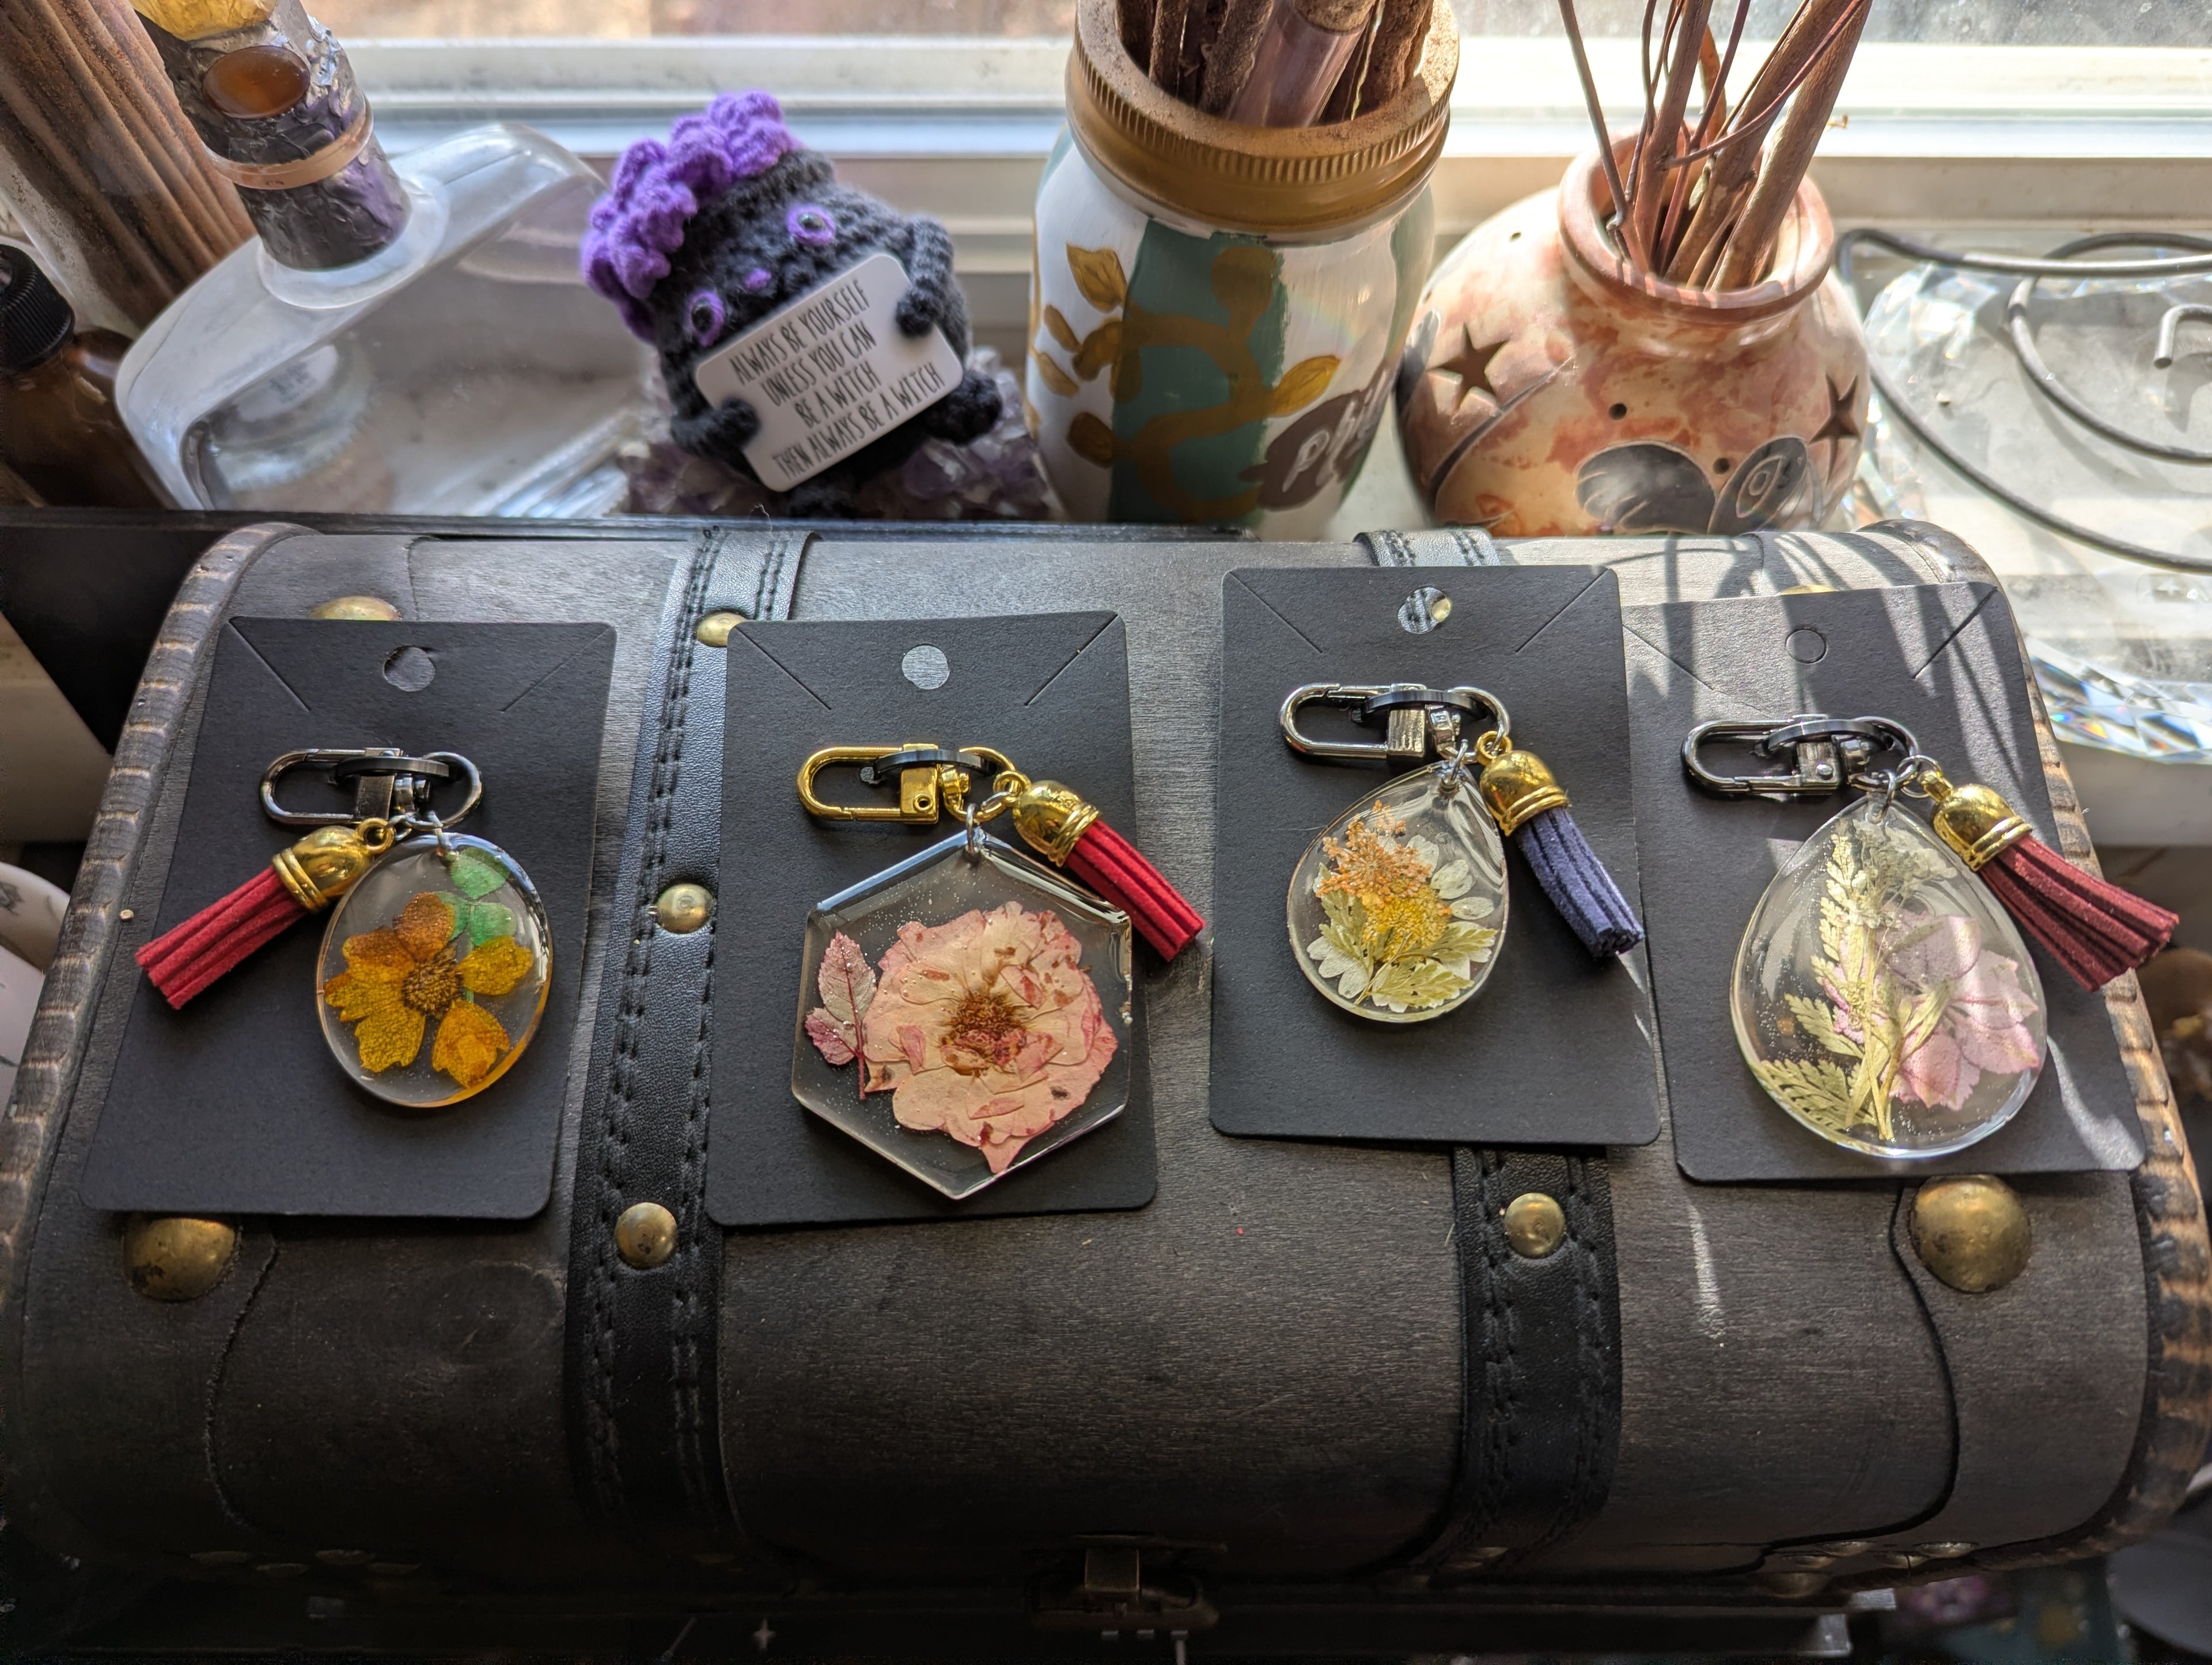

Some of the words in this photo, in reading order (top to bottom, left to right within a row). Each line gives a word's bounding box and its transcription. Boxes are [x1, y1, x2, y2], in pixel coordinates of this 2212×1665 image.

[729, 332, 787, 386] ALWAYS
[779, 321, 806, 354] BE
[797, 279, 870, 341] YOURSELF
[761, 358, 817, 407] UNLESS
[808, 339, 845, 376] YOU
[839, 320, 876, 359] CAN
[889, 362, 945, 411] WITCH
[795, 399, 821, 428] BE
[814, 385, 834, 419] A
[825, 361, 881, 409] WITCH
[858, 401, 885, 432] BE
[880, 393, 899, 421] A
[772, 442, 813, 480] THEN
[808, 412, 865, 463] ALWAYS
